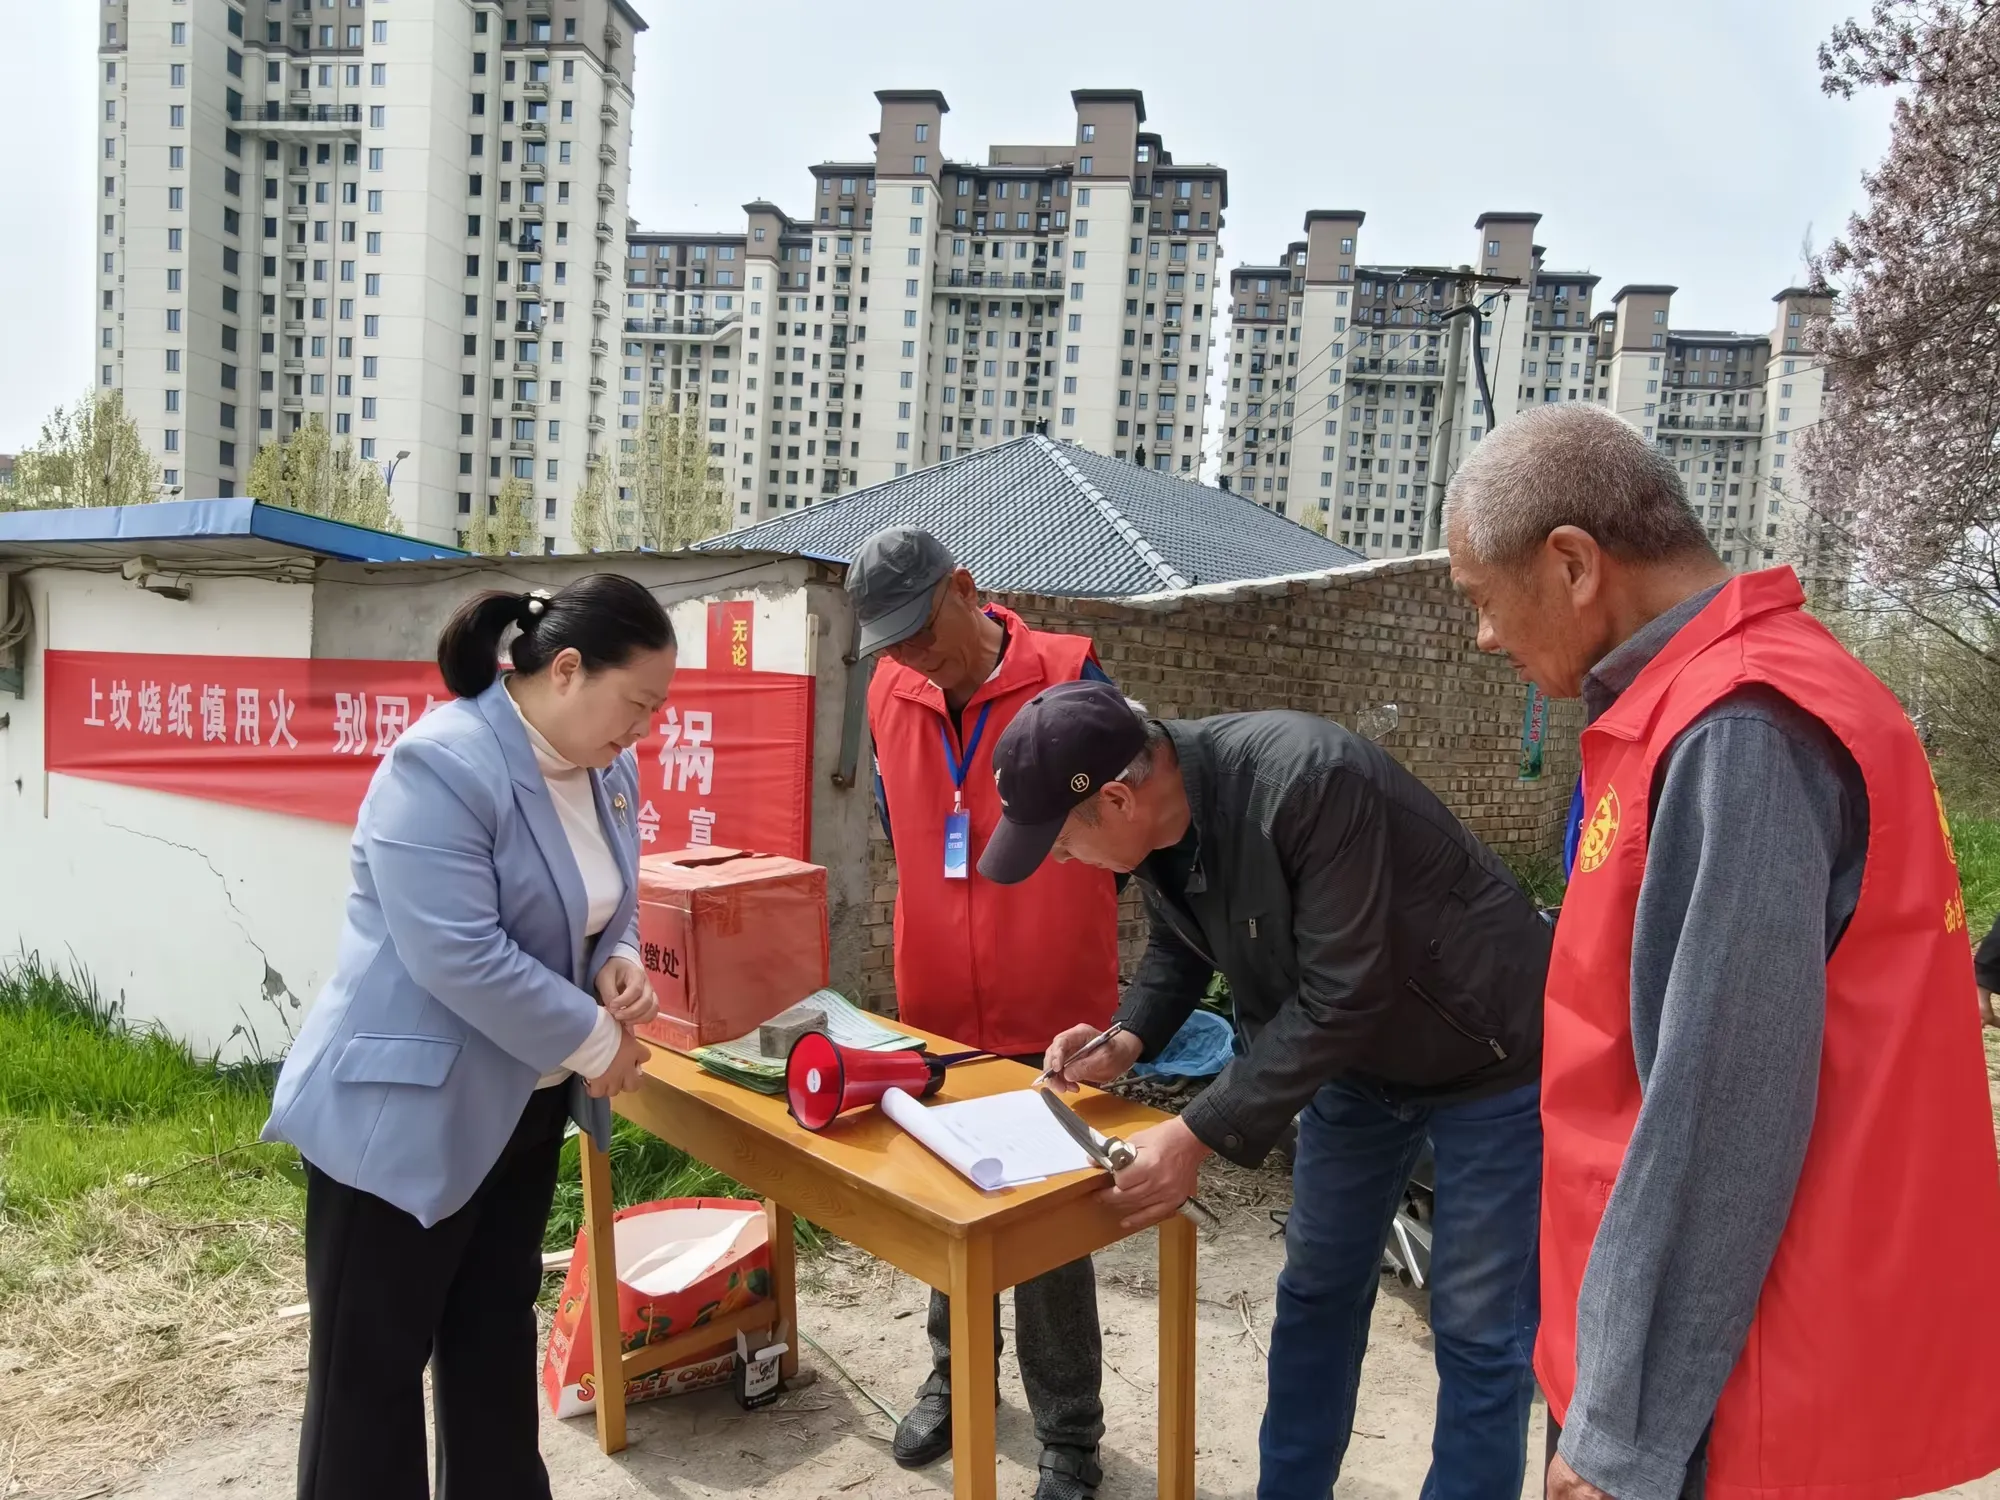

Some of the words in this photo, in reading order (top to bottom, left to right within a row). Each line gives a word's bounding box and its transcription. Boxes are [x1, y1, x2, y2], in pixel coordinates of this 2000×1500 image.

[732, 619, 747, 667] 无论
[84, 678, 298, 749] 上坟烧纸慎用火
[659, 706, 714, 796] 祸
[1072, 775, 1088, 791] H
[640, 942, 680, 980] 缴处
[577, 1372, 674, 1402] SEET
